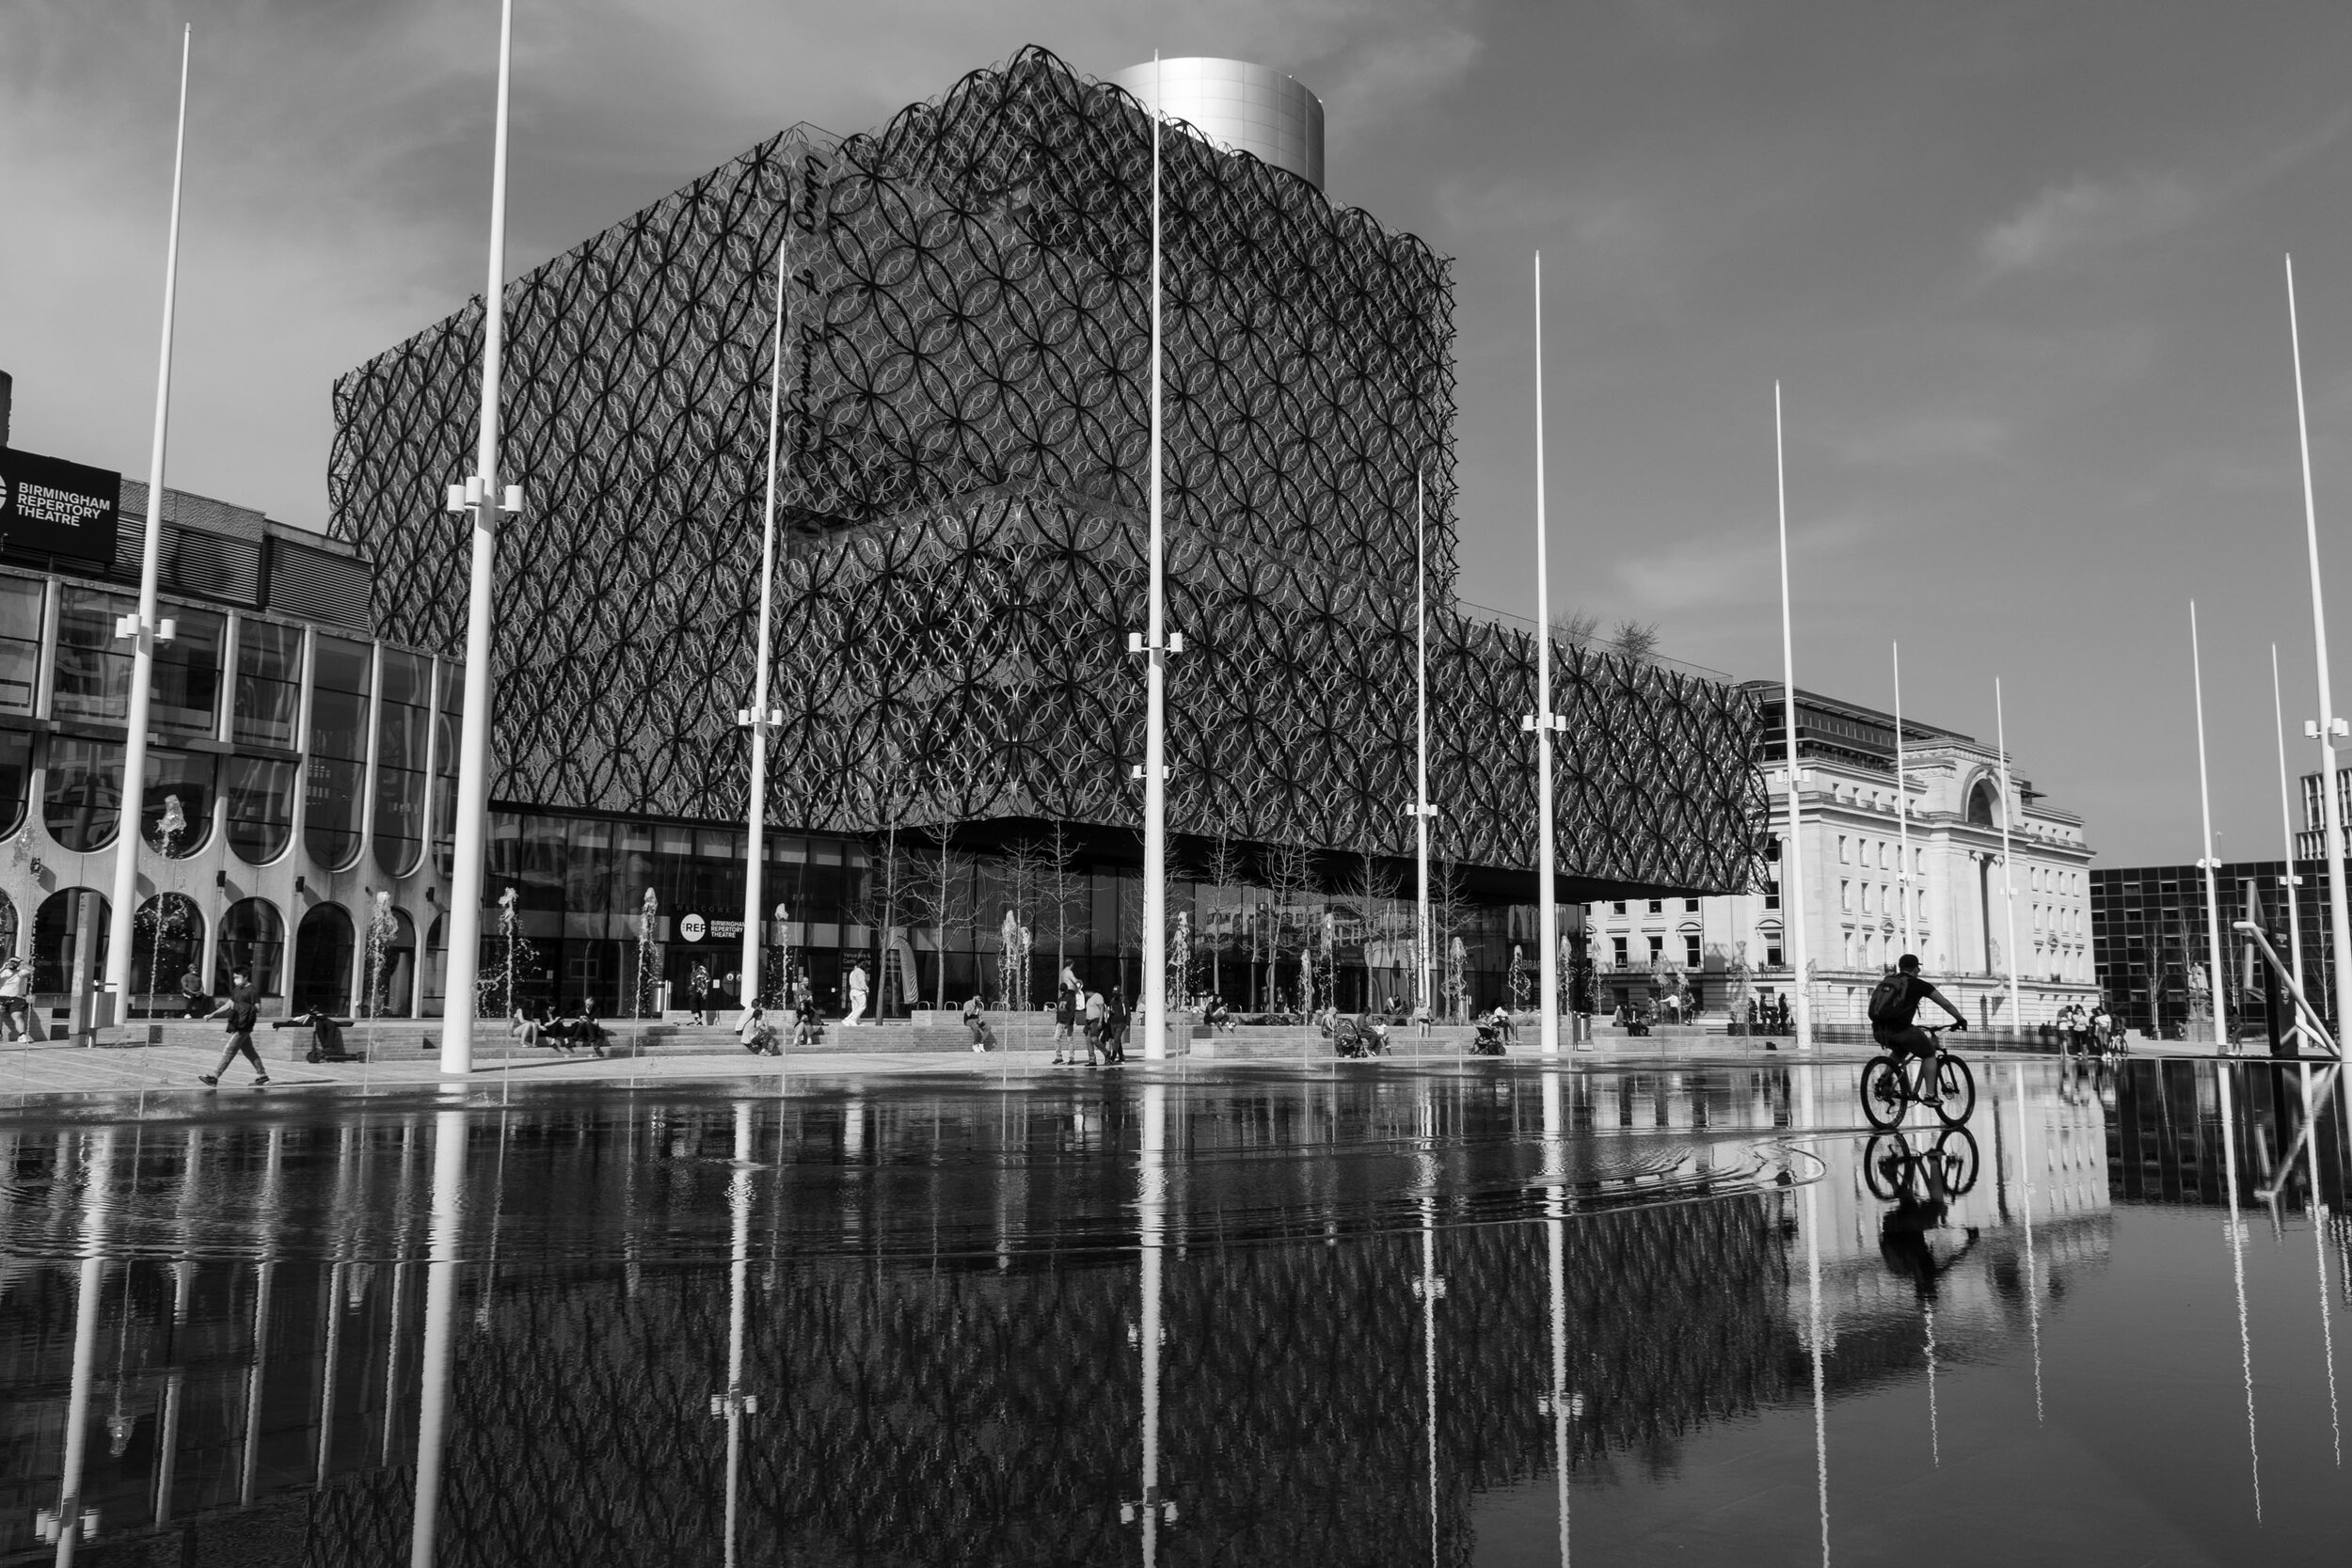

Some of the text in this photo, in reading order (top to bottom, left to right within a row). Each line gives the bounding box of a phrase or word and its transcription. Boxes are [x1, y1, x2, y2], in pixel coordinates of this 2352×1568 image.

[18, 493, 101, 519] REPERTORY
[19, 482, 110, 511] BIRMINGHAM
[16, 504, 80, 527] THEATRE
